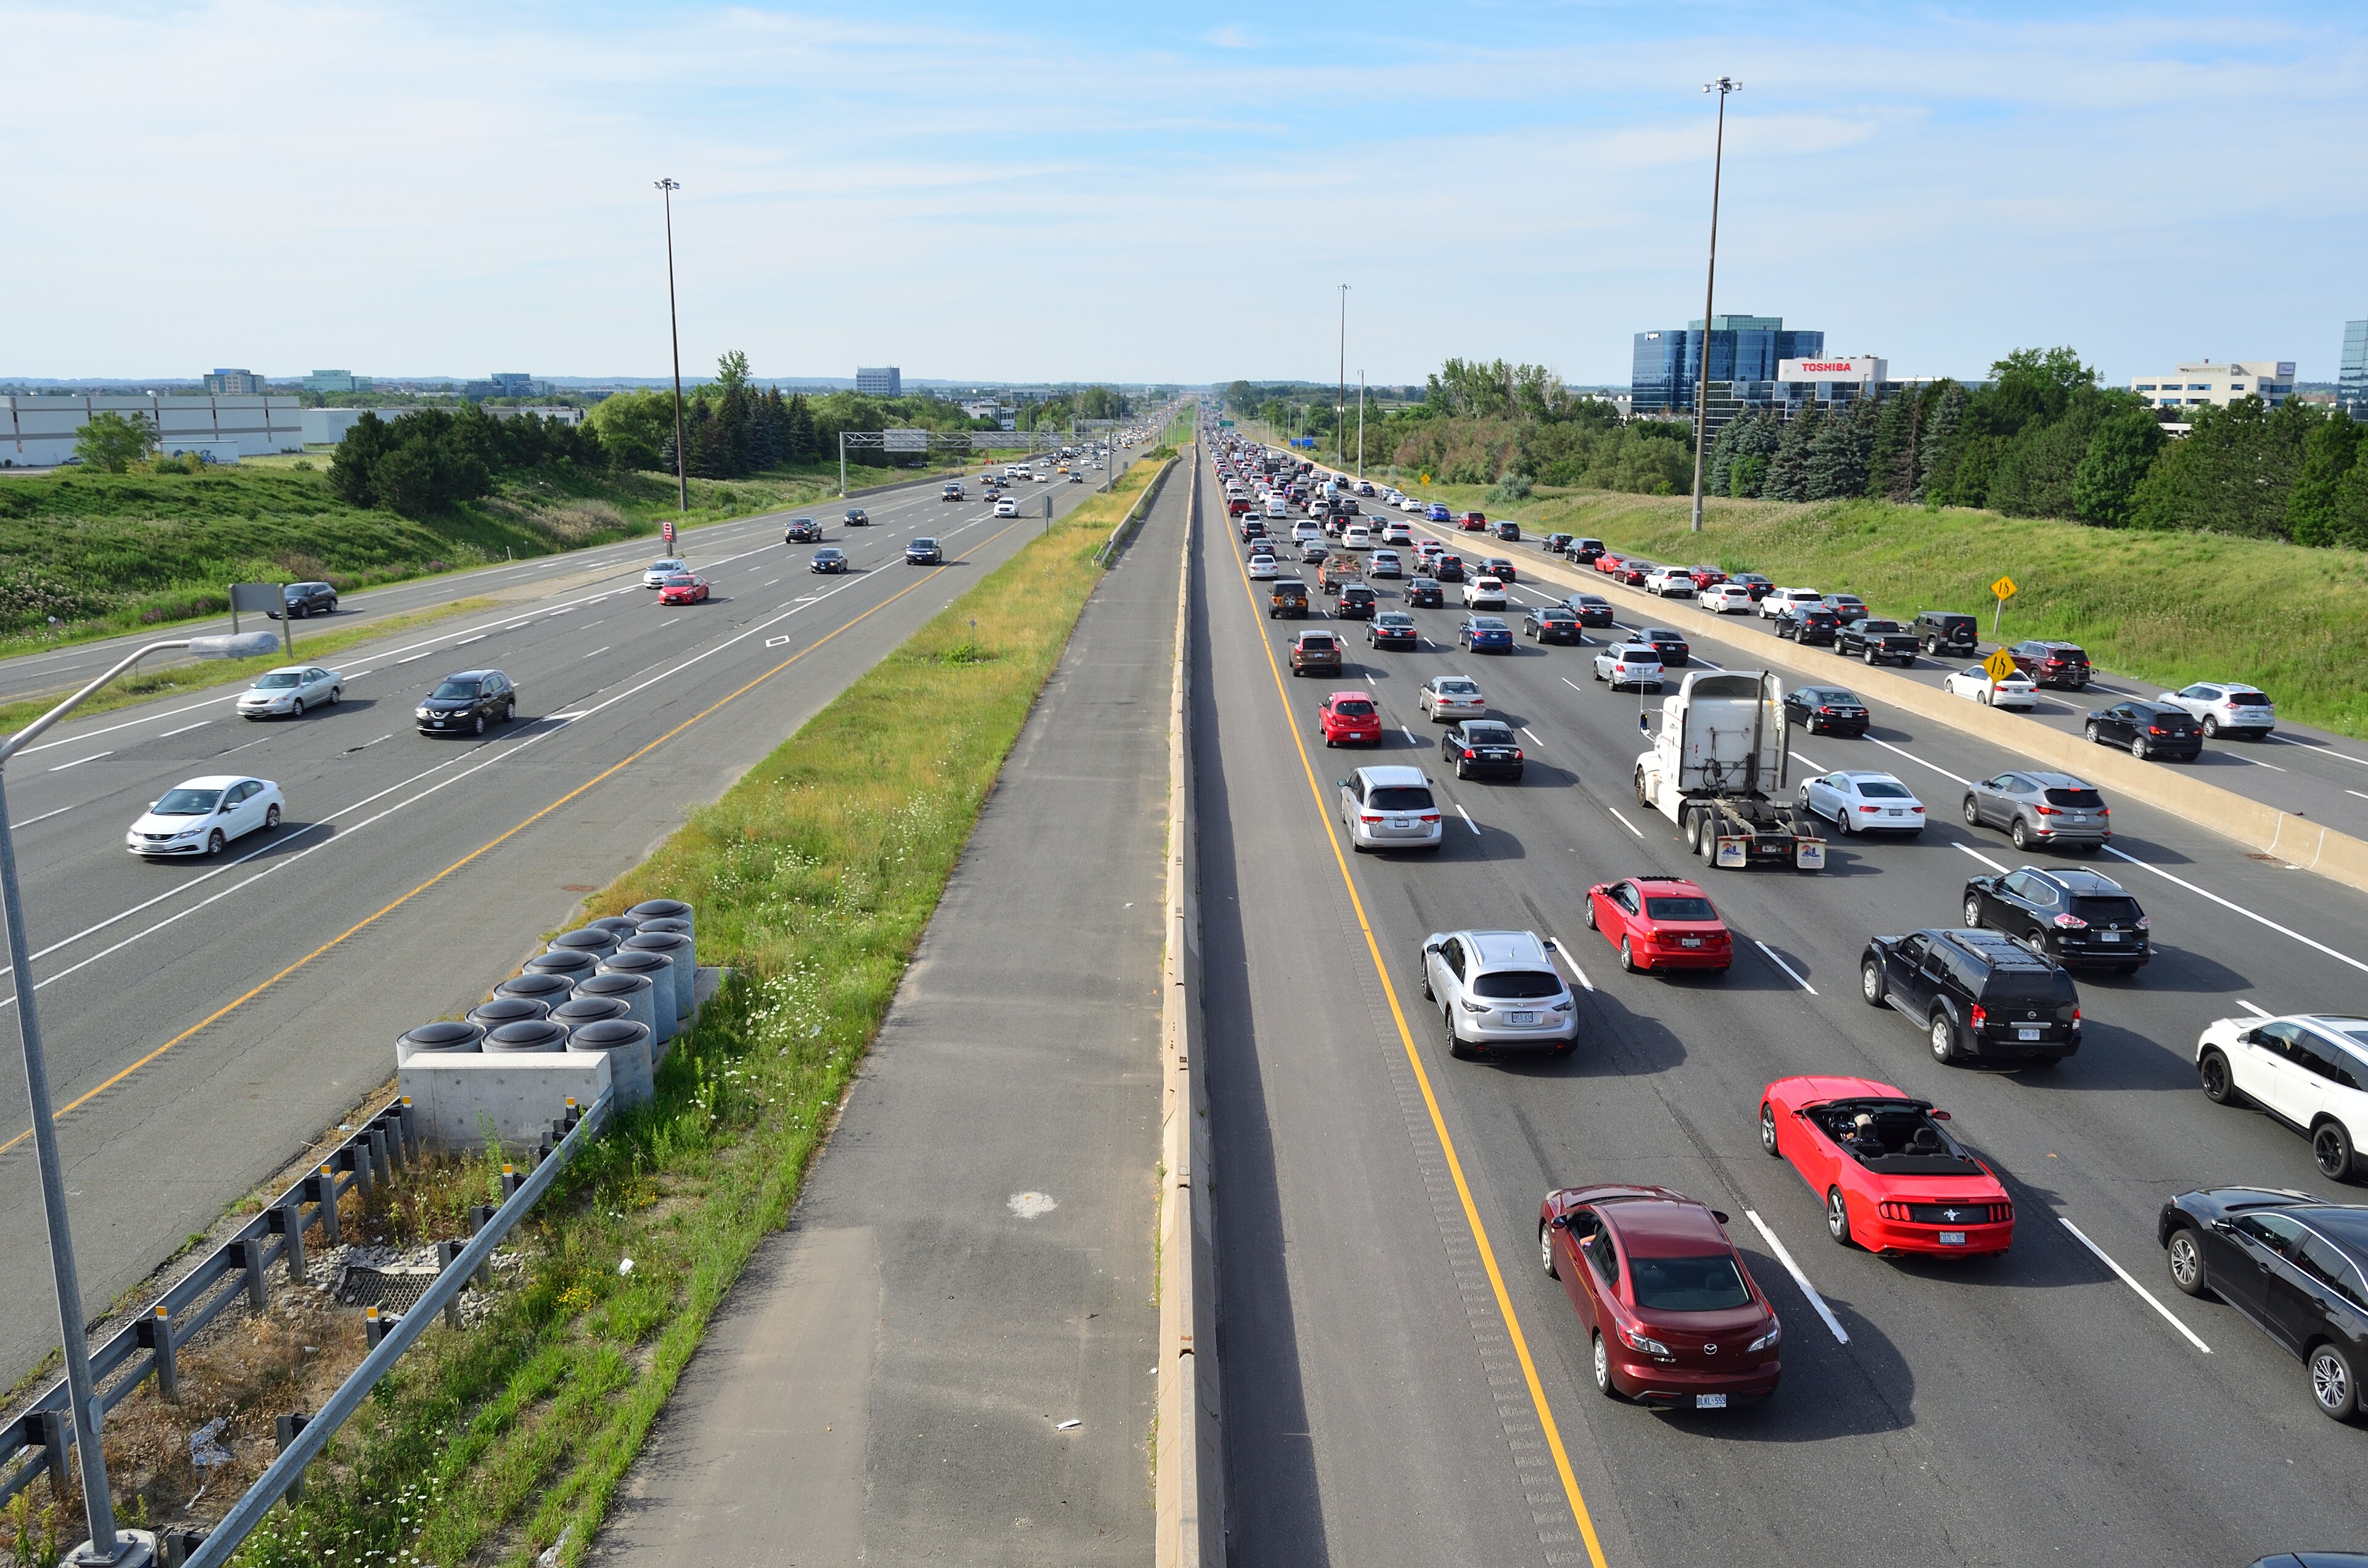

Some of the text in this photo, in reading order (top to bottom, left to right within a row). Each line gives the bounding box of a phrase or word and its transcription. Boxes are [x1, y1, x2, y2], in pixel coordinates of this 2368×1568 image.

[1802, 363, 1851, 371] TOSHIBA
[1697, 1397, 1726, 1406] BLKL 559
